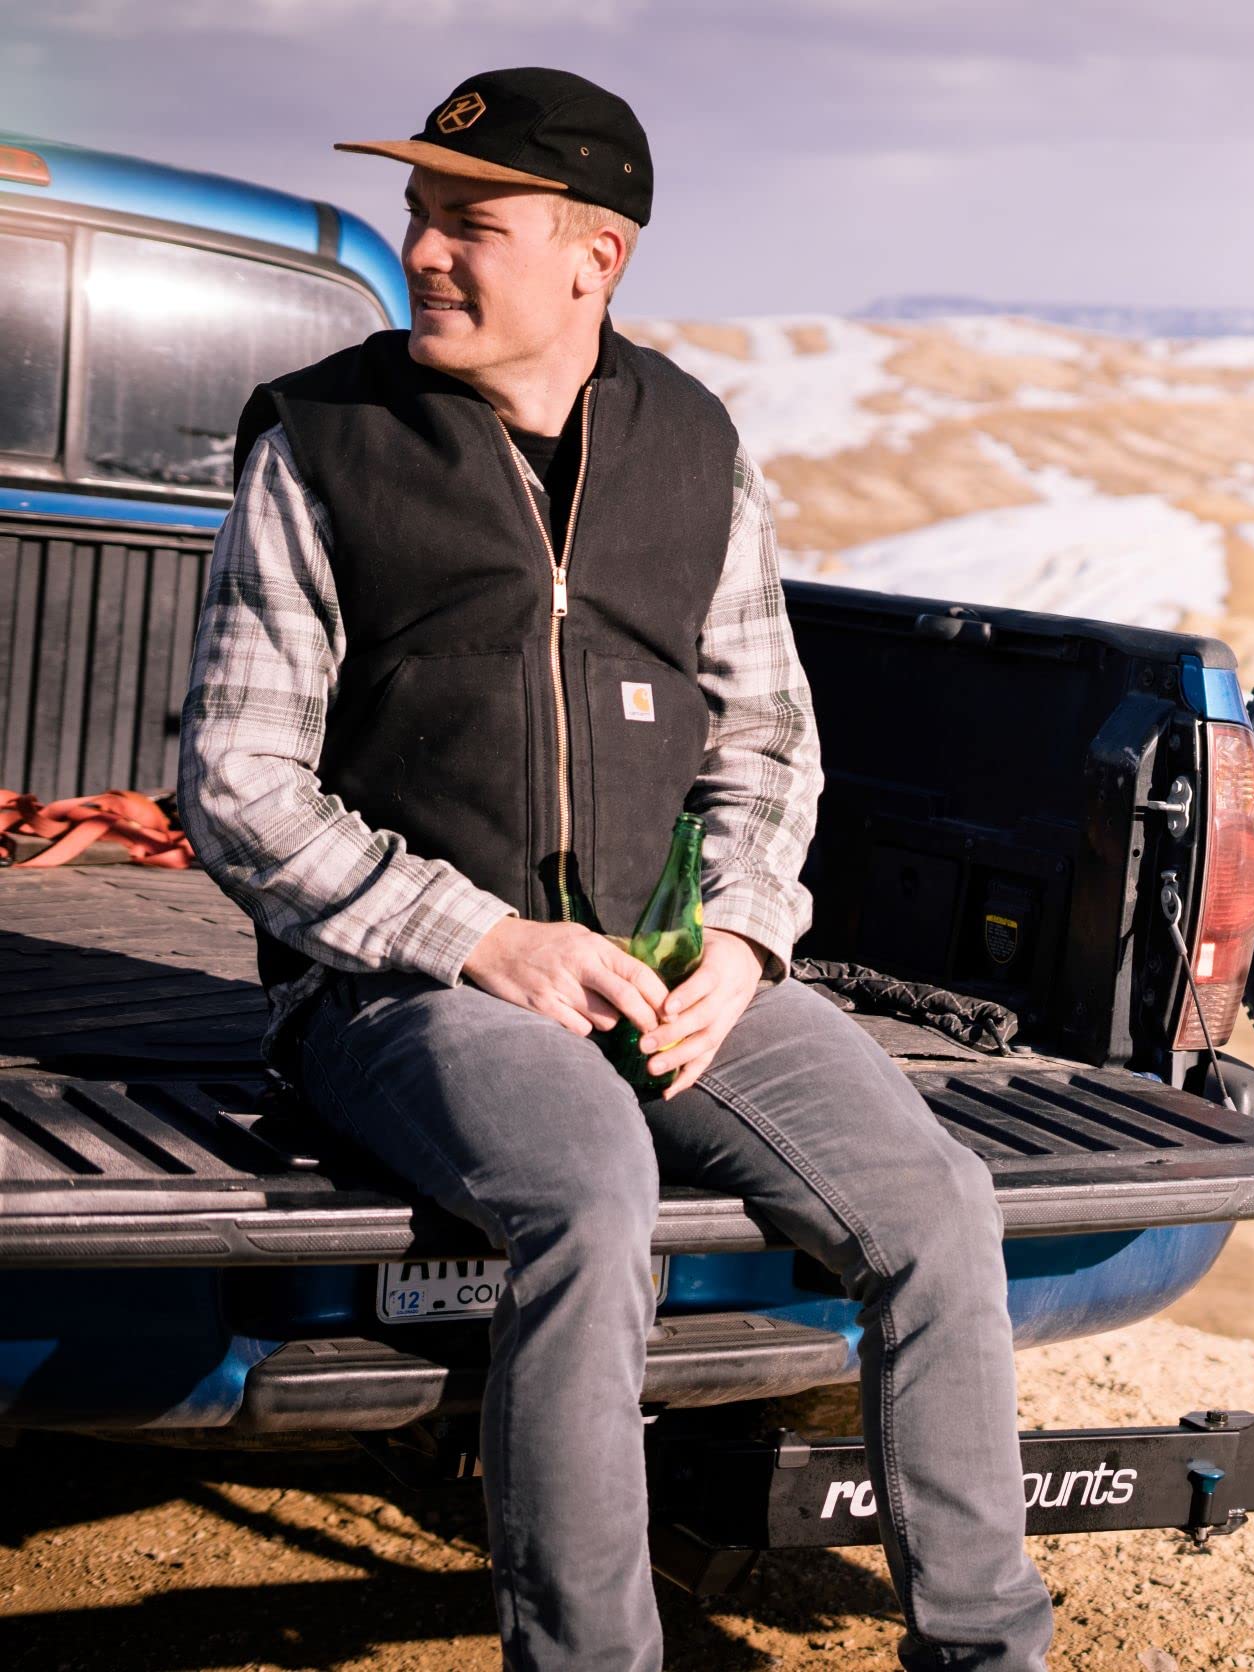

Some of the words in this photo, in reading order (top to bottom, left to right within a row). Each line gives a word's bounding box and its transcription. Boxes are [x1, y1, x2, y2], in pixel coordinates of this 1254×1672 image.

[397, 1291, 420, 1310] 12
[820, 1480, 878, 1519] ro
[1022, 1462, 1138, 1508] ounts
